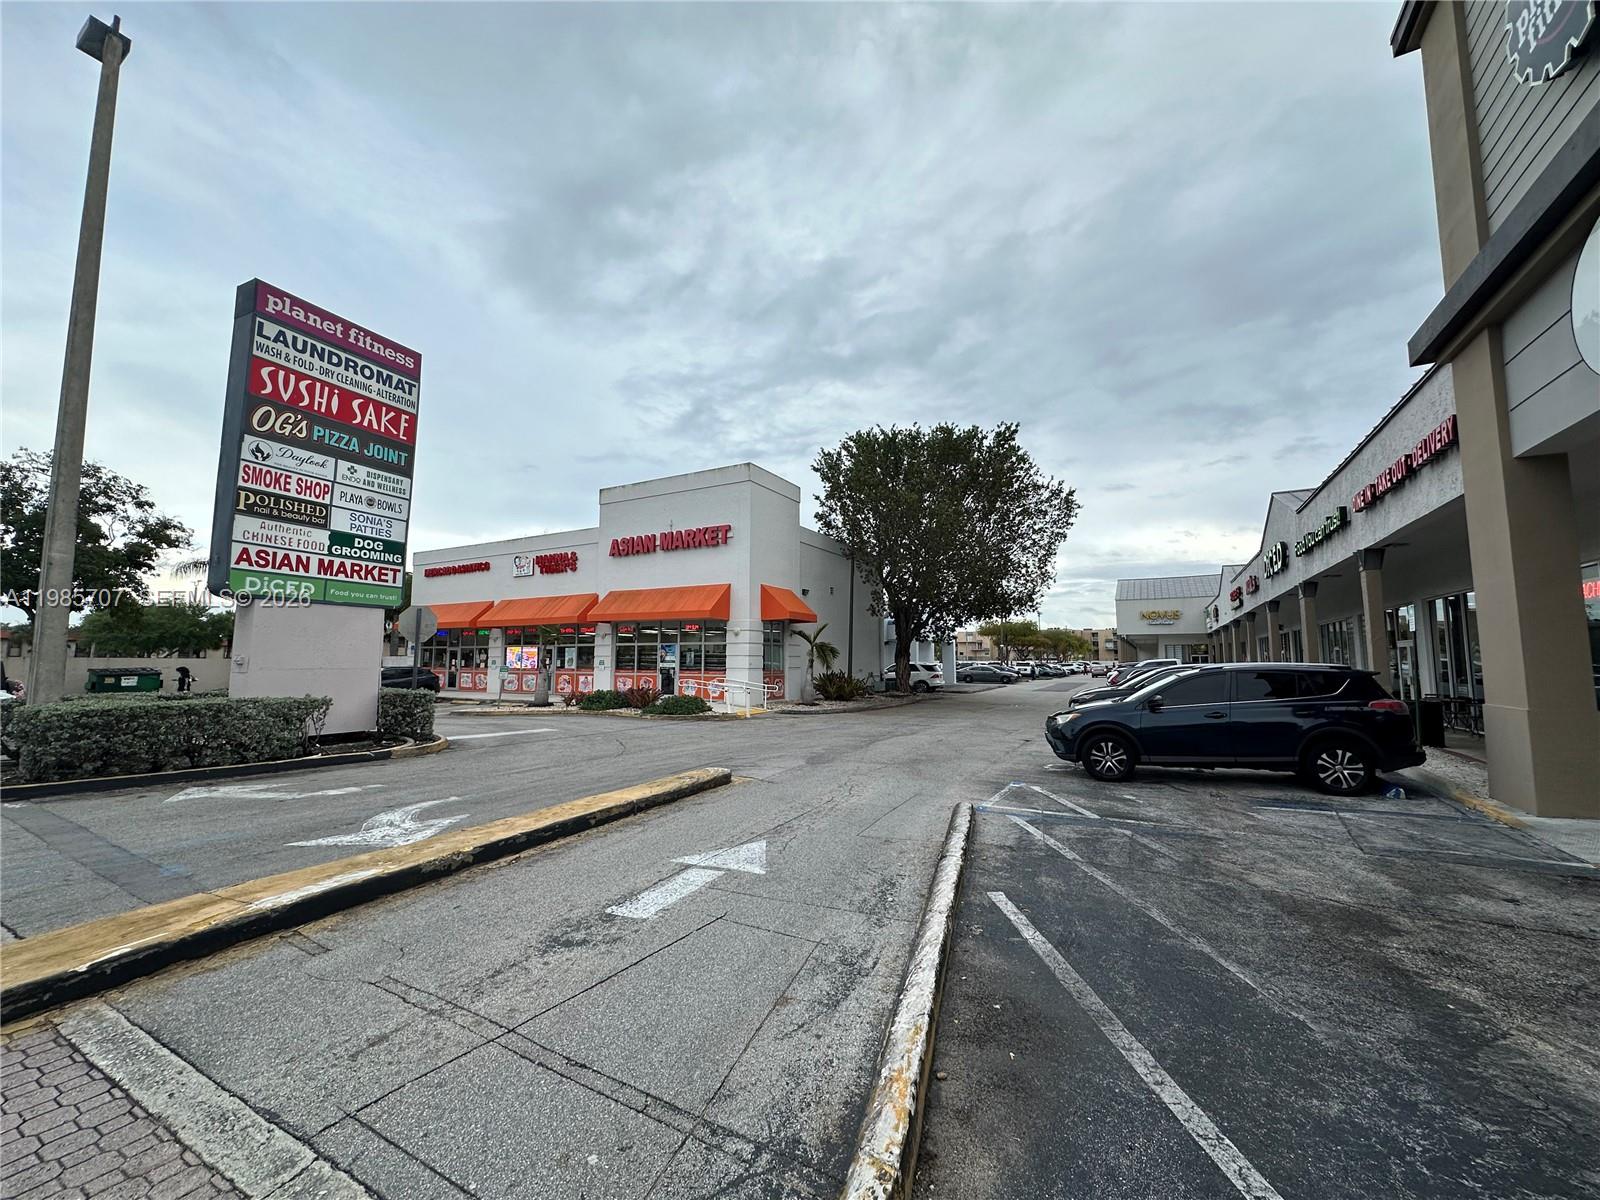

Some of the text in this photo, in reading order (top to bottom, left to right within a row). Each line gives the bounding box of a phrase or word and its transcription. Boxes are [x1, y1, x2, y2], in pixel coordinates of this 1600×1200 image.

[265, 294, 415, 369] planet fitness
[255, 340, 283, 360] WASH
[284, 352, 291, 363] &
[256, 320, 417, 396] LAUNDROMAT
[351, 398, 410, 441] SAKE
[312, 425, 360, 453] PIZZA
[364, 443, 409, 467] JOINT
[1375, 467, 1392, 496] TAKE
[1391, 455, 1407, 483] OUT
[1411, 415, 1455, 468] DELIVERY
[275, 446, 329, 470] Daylook
[241, 464, 292, 493] SMOKE
[295, 477, 331, 501] SHOP
[362, 479, 407, 496] AND WELLNESS
[366, 470, 404, 487] DISPENSARY
[236, 490, 327, 517] POLISHED
[339, 491, 403, 514] PLAYA BOWLS
[253, 506, 326, 525] nail & beauty bar
[349, 512, 393, 528] SONIA'S
[242, 530, 326, 552] CHINESE FOOD
[260, 521, 313, 538] Authentic
[349, 523, 393, 539] PATTIES
[608, 524, 732, 557] ASIAN MARKET
[331, 544, 402, 563] GROOMING
[354, 537, 384, 551] DOG
[234, 547, 402, 584] ASIAN MARKET
[330, 589, 349, 597] Food
[350, 591, 364, 600] you
[379, 593, 398, 601] trust!
[1140, 608, 1182, 620] NOVUS
